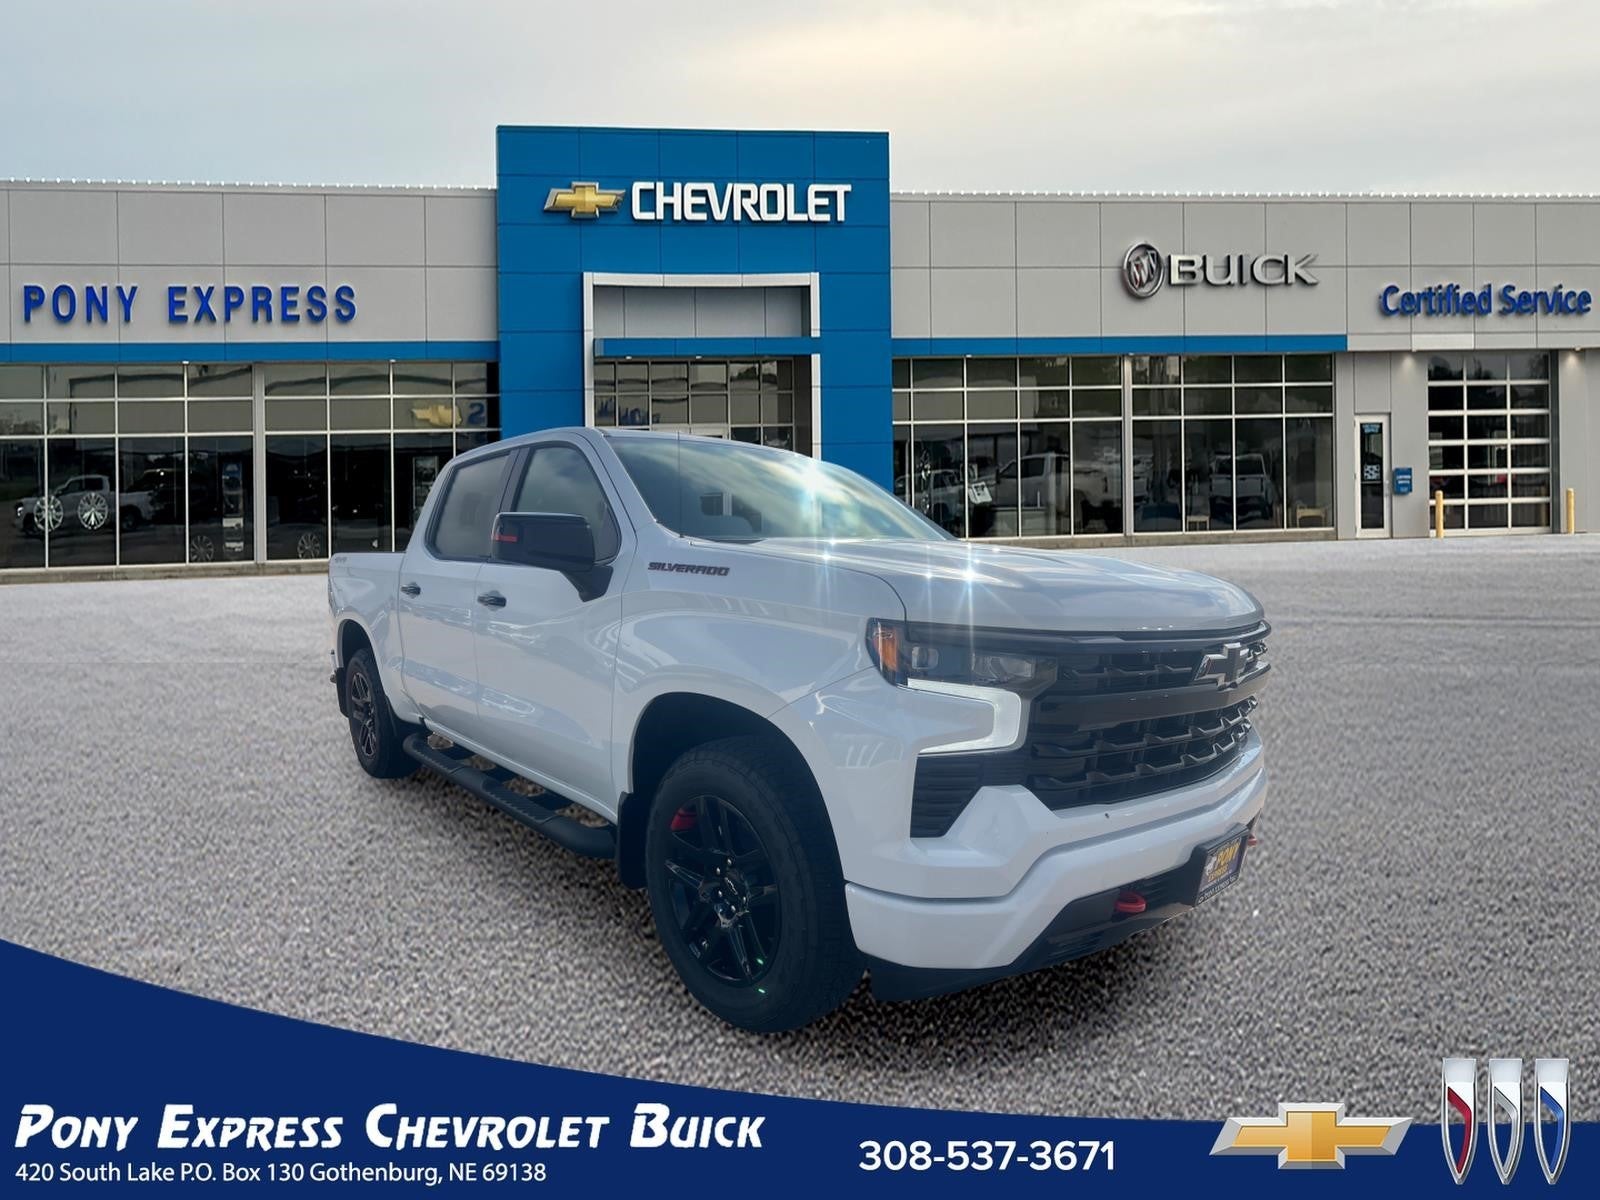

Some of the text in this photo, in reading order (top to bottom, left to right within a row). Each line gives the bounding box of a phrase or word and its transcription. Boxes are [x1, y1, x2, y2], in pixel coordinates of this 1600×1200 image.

[631, 181, 852, 222] CHEVROLET
[1168, 254, 1319, 286] BUICK
[23, 285, 358, 324] PONY EXPRESS
[1380, 284, 1592, 316] Certified Service
[648, 561, 730, 577] SILVERADO
